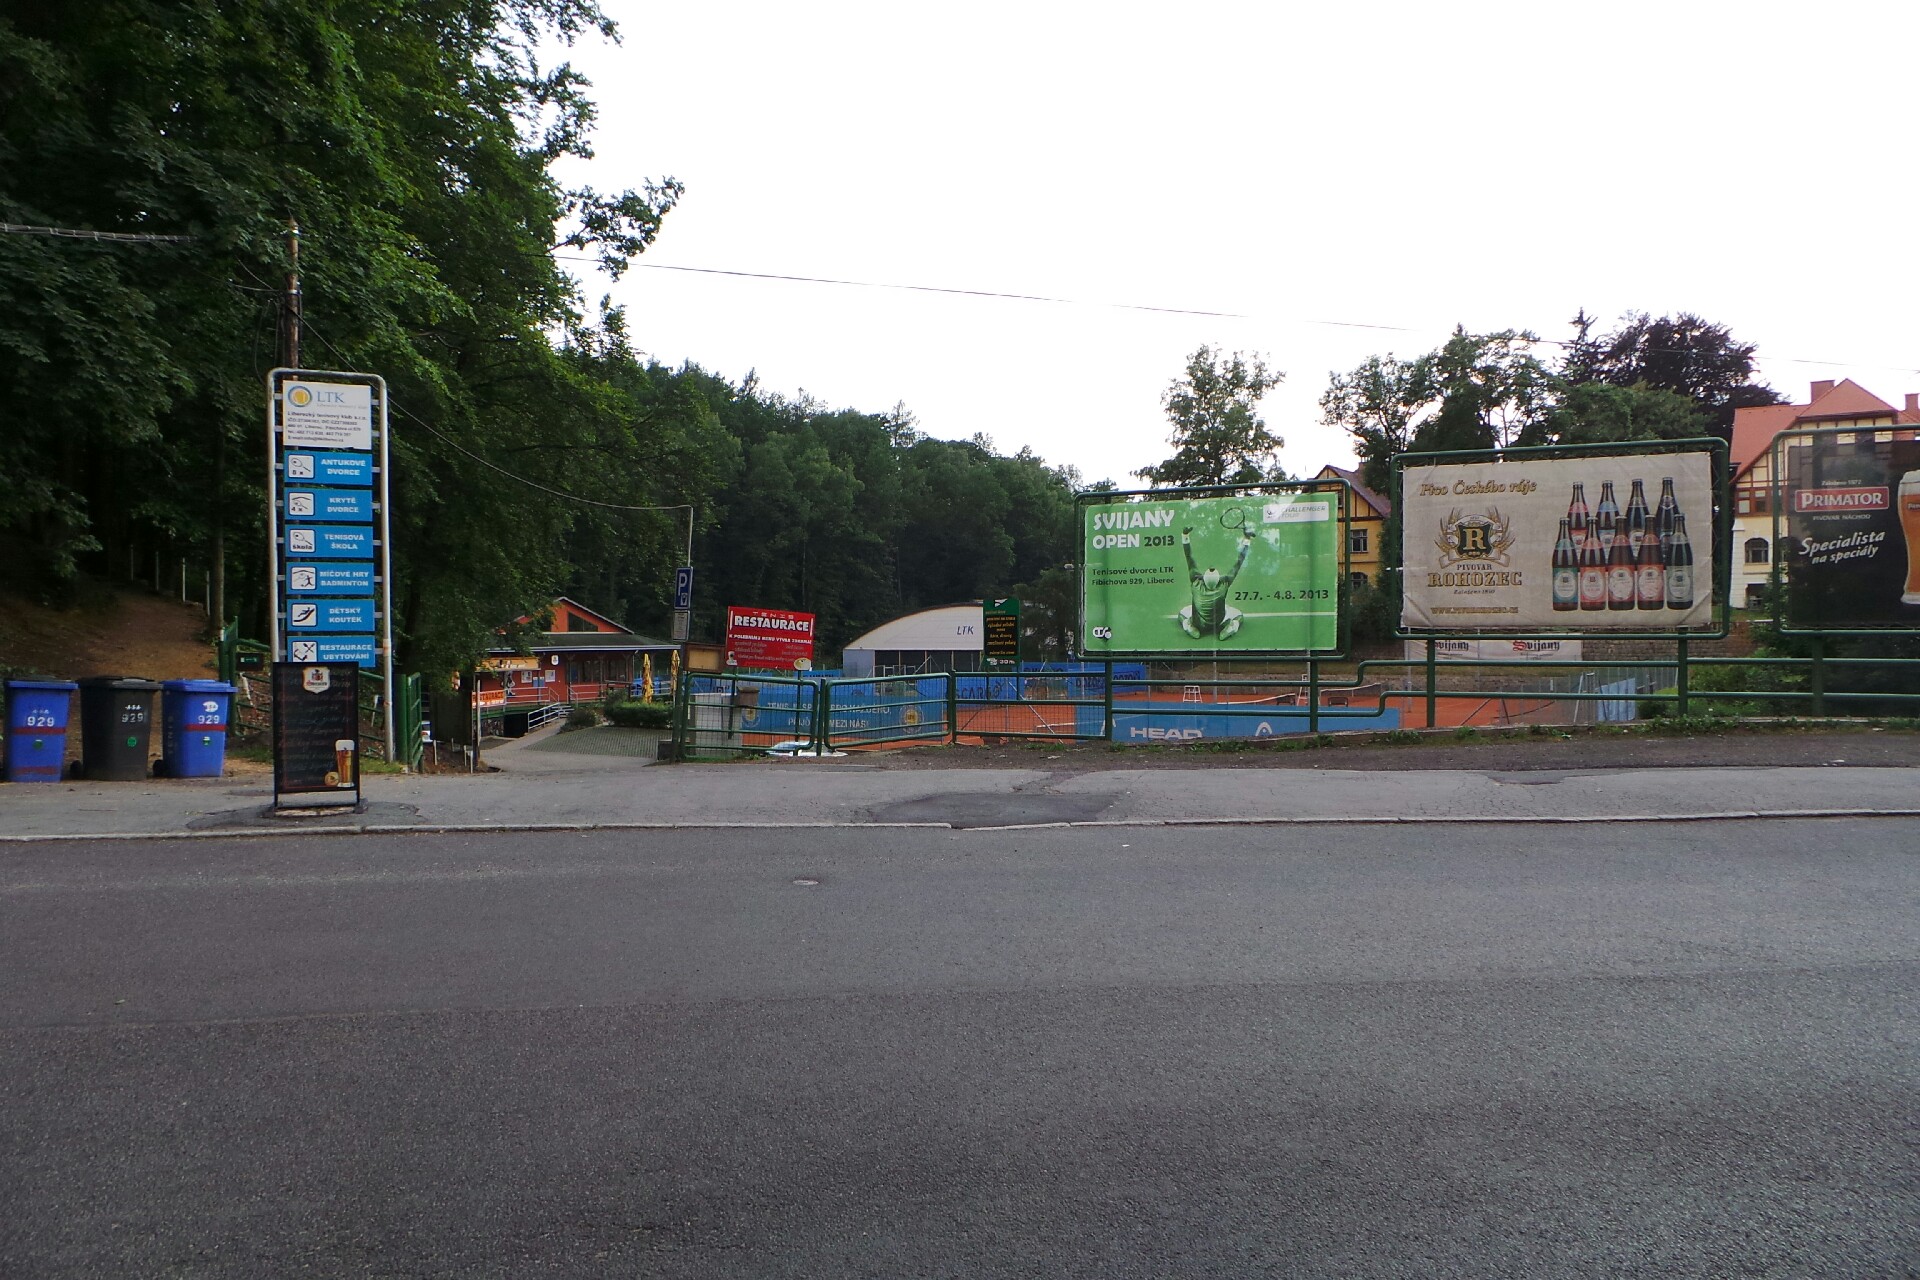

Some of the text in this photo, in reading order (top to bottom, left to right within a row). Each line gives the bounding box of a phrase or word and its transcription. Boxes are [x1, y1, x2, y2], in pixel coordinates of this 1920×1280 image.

[317, 391, 345, 404] LTK
[327, 468, 361, 476] DVORCE
[1419, 478, 1537, 496] Pivo Českého ráje
[1801, 492, 1884, 509] PRIMATOR
[1093, 509, 1175, 530] SVIJANY
[1092, 534, 1175, 549] OPEN 2013
[1462, 528, 1487, 550] R
[1798, 531, 1886, 557] Specialista
[331, 542, 358, 550] ŠKOLA
[1811, 544, 1879, 565] na speciály
[1092, 567, 1128, 576] Tenisové
[1129, 567, 1157, 575] dvorce
[1456, 563, 1493, 571] PIVOVAR
[677, 572, 688, 597] P
[1091, 577, 1127, 586] Fibichova
[1427, 571, 1522, 587] ROHOZEC
[1234, 591, 1263, 601] 27.7.
[1273, 590, 1296, 600] 4.8.
[1299, 589, 1329, 600] 2013
[734, 615, 810, 632] RESTAURACE
[956, 625, 974, 636] LTK
[1426, 640, 1469, 652] vijany
[1512, 640, 1560, 652] Svijany
[27, 716, 55, 727] 929
[121, 713, 144, 723] 929
[197, 715, 220, 724] 929
[1130, 727, 1203, 740] HEAD
